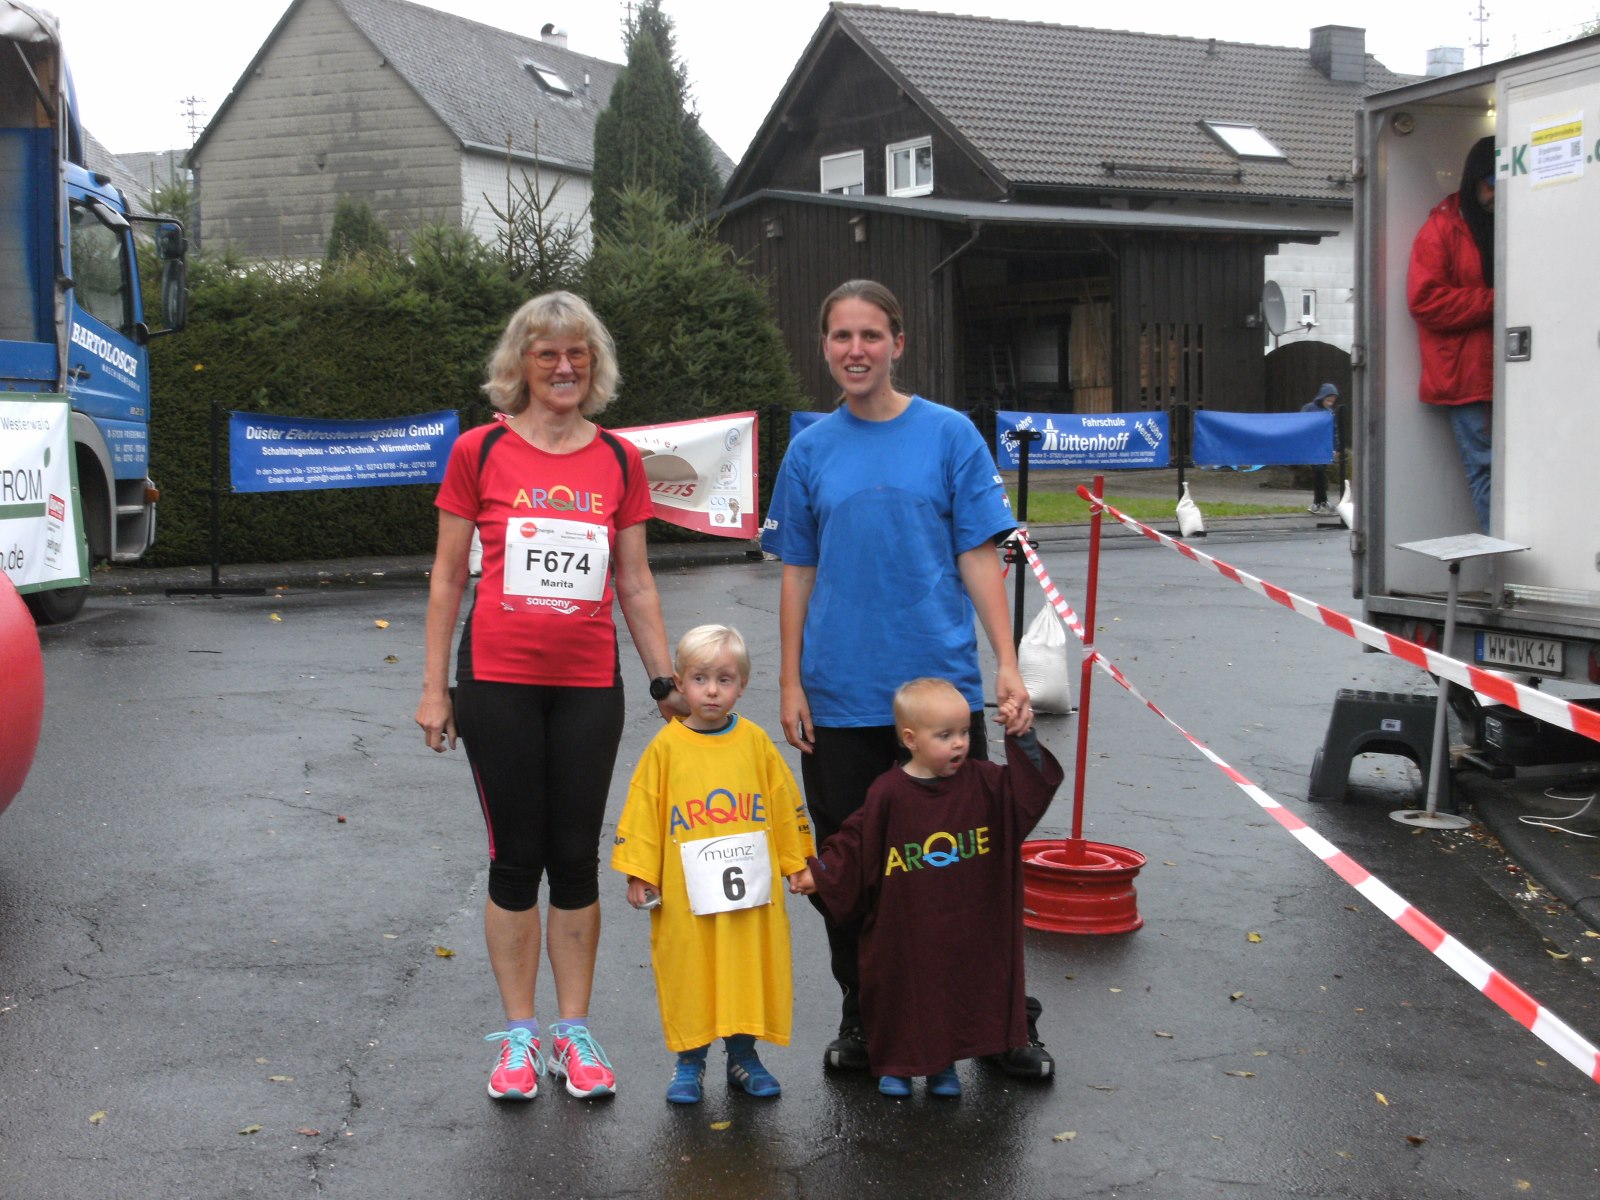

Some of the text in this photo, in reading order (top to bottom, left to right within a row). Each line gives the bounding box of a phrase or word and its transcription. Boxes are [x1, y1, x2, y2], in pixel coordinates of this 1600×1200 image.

[71, 322, 138, 377] BARTOLOSCH
[1, 417, 50, 431] Westerwald
[246, 423, 444, 441] Düster Elektrosteuerungsbau GmbH
[1082, 417, 1126, 427] Fahrschule
[1134, 421, 1159, 449] Herdorf
[262, 446, 324, 457] Schaltanlagenbau
[328, 445, 376, 455] CNC-Technik
[380, 442, 431, 453] Wärmetechnik
[323, 464, 351, 473] Friedewald
[512, 485, 603, 515] ARQUE
[526, 549, 591, 575] F674
[541, 578, 574, 589] Marita
[526, 597, 570, 609] saucony
[1488, 636, 1556, 667] WW VK 14
[669, 788, 767, 835] ARQUE
[704, 844, 753, 862] münz
[885, 826, 990, 876] ARQUE
[722, 866, 746, 901] 6
